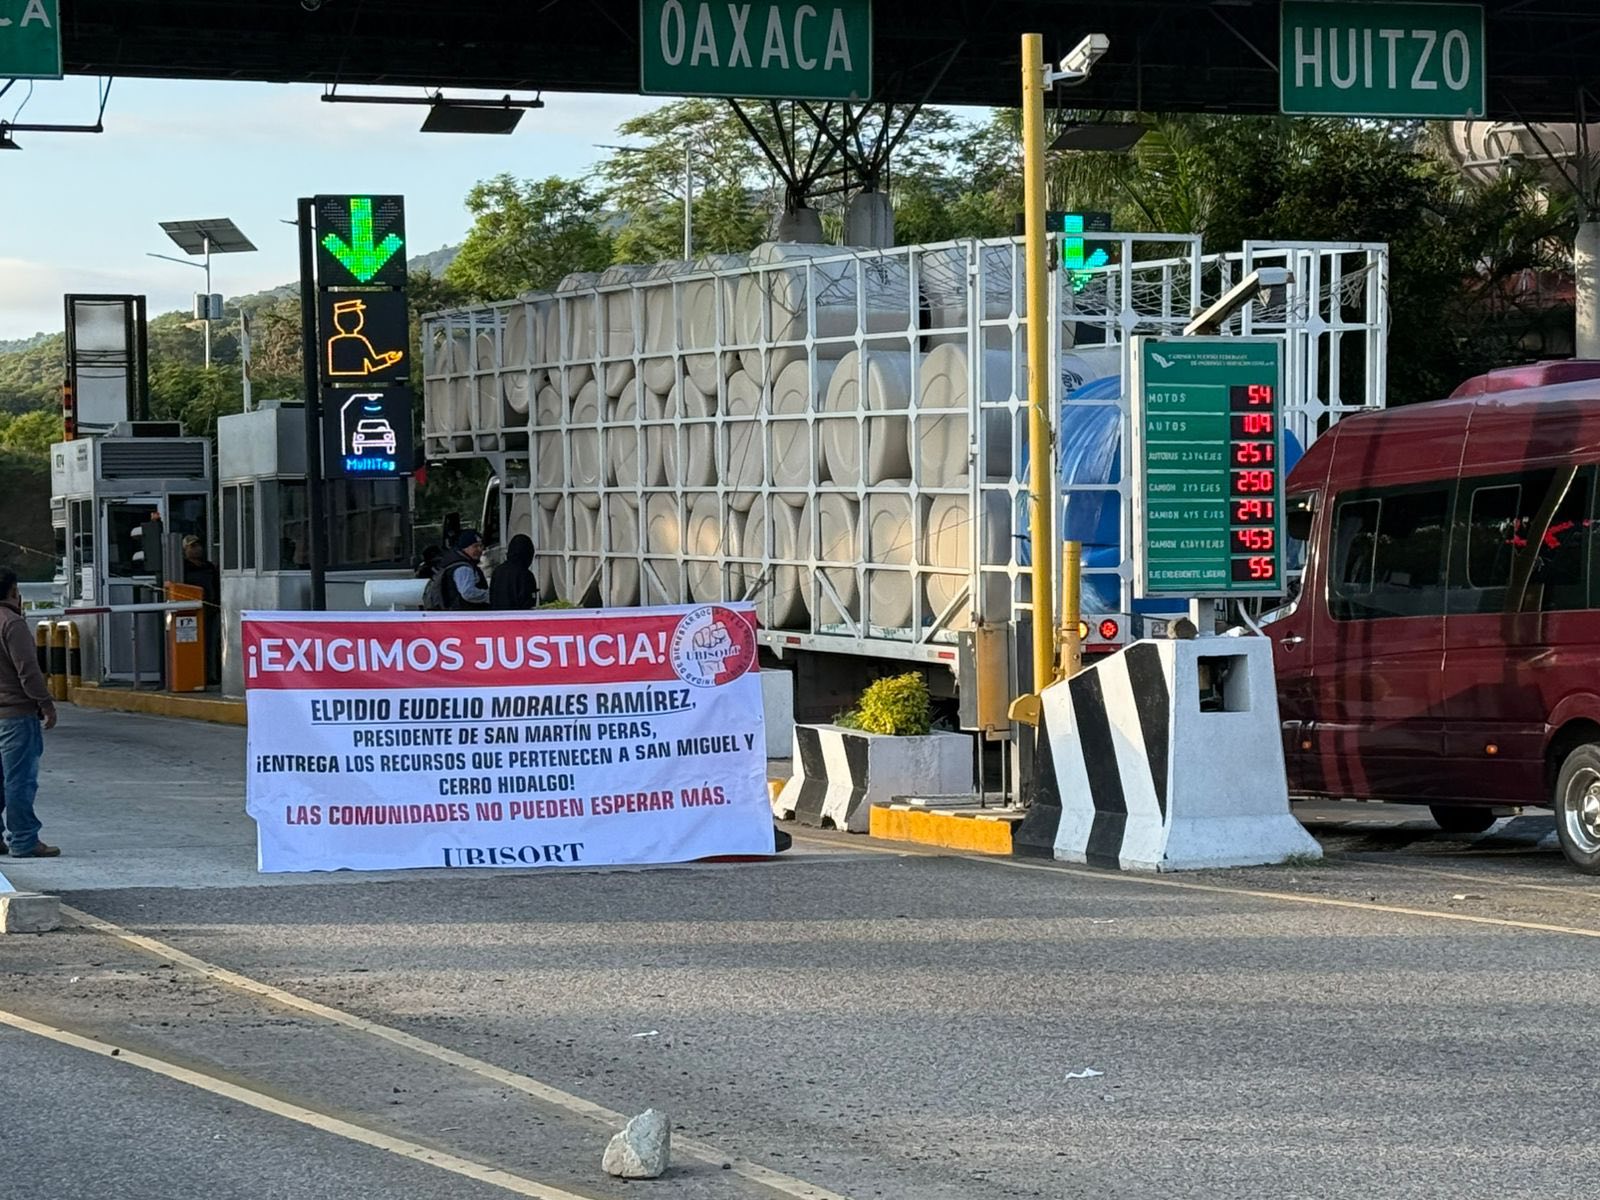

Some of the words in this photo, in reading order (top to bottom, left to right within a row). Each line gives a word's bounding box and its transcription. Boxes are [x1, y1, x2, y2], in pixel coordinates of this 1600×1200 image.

[0, 0, 52, 28] A
[660, 0, 853, 71] OAXACA
[1295, 27, 1470, 91] HUITZO
[1148, 393, 1187, 403] MOTOS
[1248, 385, 1271, 405] 54
[1148, 421, 1187, 431] AUTOS
[1243, 413, 1271, 433] 109
[1237, 442, 1271, 462] 251
[1200, 483, 1221, 492] EJES
[1237, 471, 1272, 491] 250
[1237, 500, 1272, 520] 291
[1238, 528, 1273, 549] 453
[1249, 557, 1273, 578] 55
[248, 637, 465, 678] ¡EXIGIMOS
[474, 631, 667, 671] JUSTICIA!
[311, 698, 391, 721] ELPIDIO
[399, 696, 483, 720] EUDELIO
[491, 693, 589, 718] MORALES
[596, 685, 696, 714] RAMÍREZ,
[353, 728, 452, 748] PRESIDENTE
[458, 727, 478, 745] DE
[484, 726, 519, 744] SAN
[525, 720, 591, 743] MARTÍN
[597, 721, 657, 741] PERAS,
[256, 754, 340, 773] ¡ENTREGA
[345, 754, 375, 772] LOS
[380, 752, 466, 771] RECURSOS
[472, 751, 503, 770] QUE
[509, 747, 613, 768] PERTENECEN
[618, 746, 630, 763] A
[635, 741, 671, 761] SAN
[677, 734, 740, 757] MIGUEL
[744, 733, 755, 751] Y
[439, 775, 492, 796] CERRO
[498, 773, 576, 794] HIDALGO!
[286, 805, 321, 825] LAS
[328, 802, 470, 826] COMUNIDADES
[476, 801, 503, 822] NO
[509, 797, 584, 821] PUEDEN
[591, 789, 675, 816] ESPERAR
[680, 781, 732, 807] MÁS.
[441, 843, 584, 867] UBISORT
